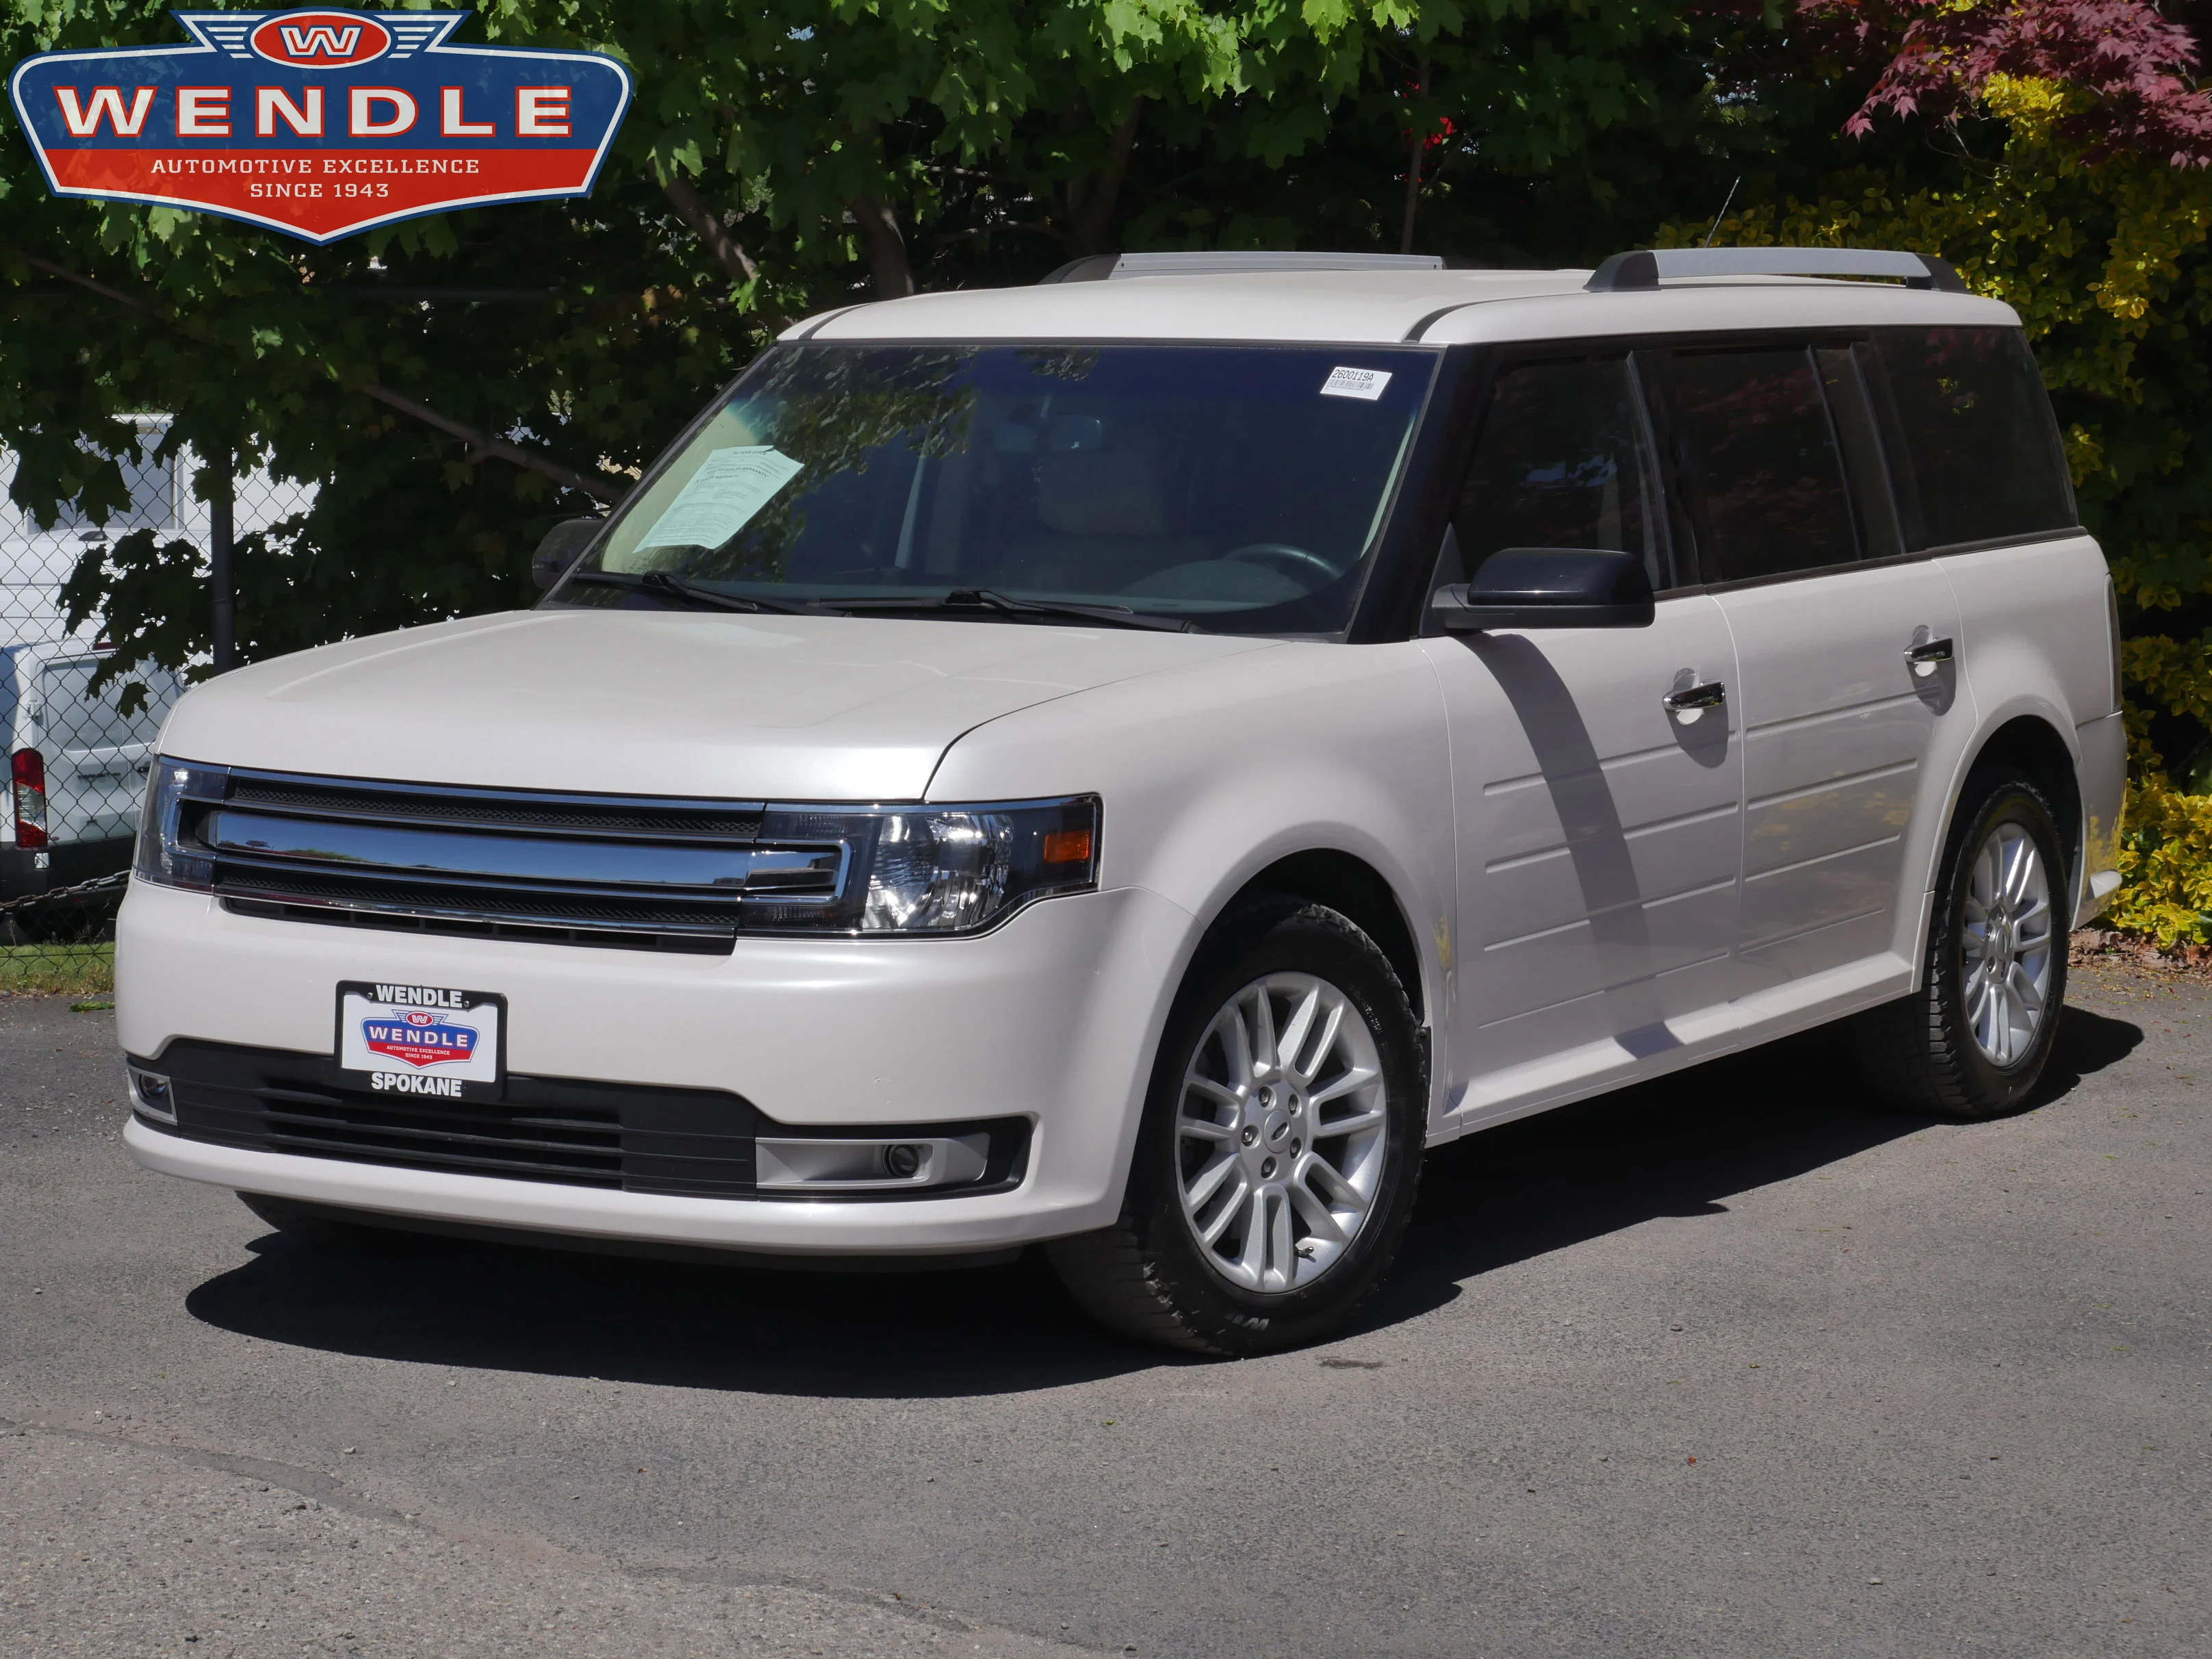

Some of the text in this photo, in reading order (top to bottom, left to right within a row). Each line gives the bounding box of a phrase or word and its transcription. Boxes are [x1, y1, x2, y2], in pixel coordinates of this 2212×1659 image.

[376, 984, 463, 1008] WENDLE
[369, 1026, 468, 1047] WENDLE
[371, 1072, 462, 1097] SPOKANE
